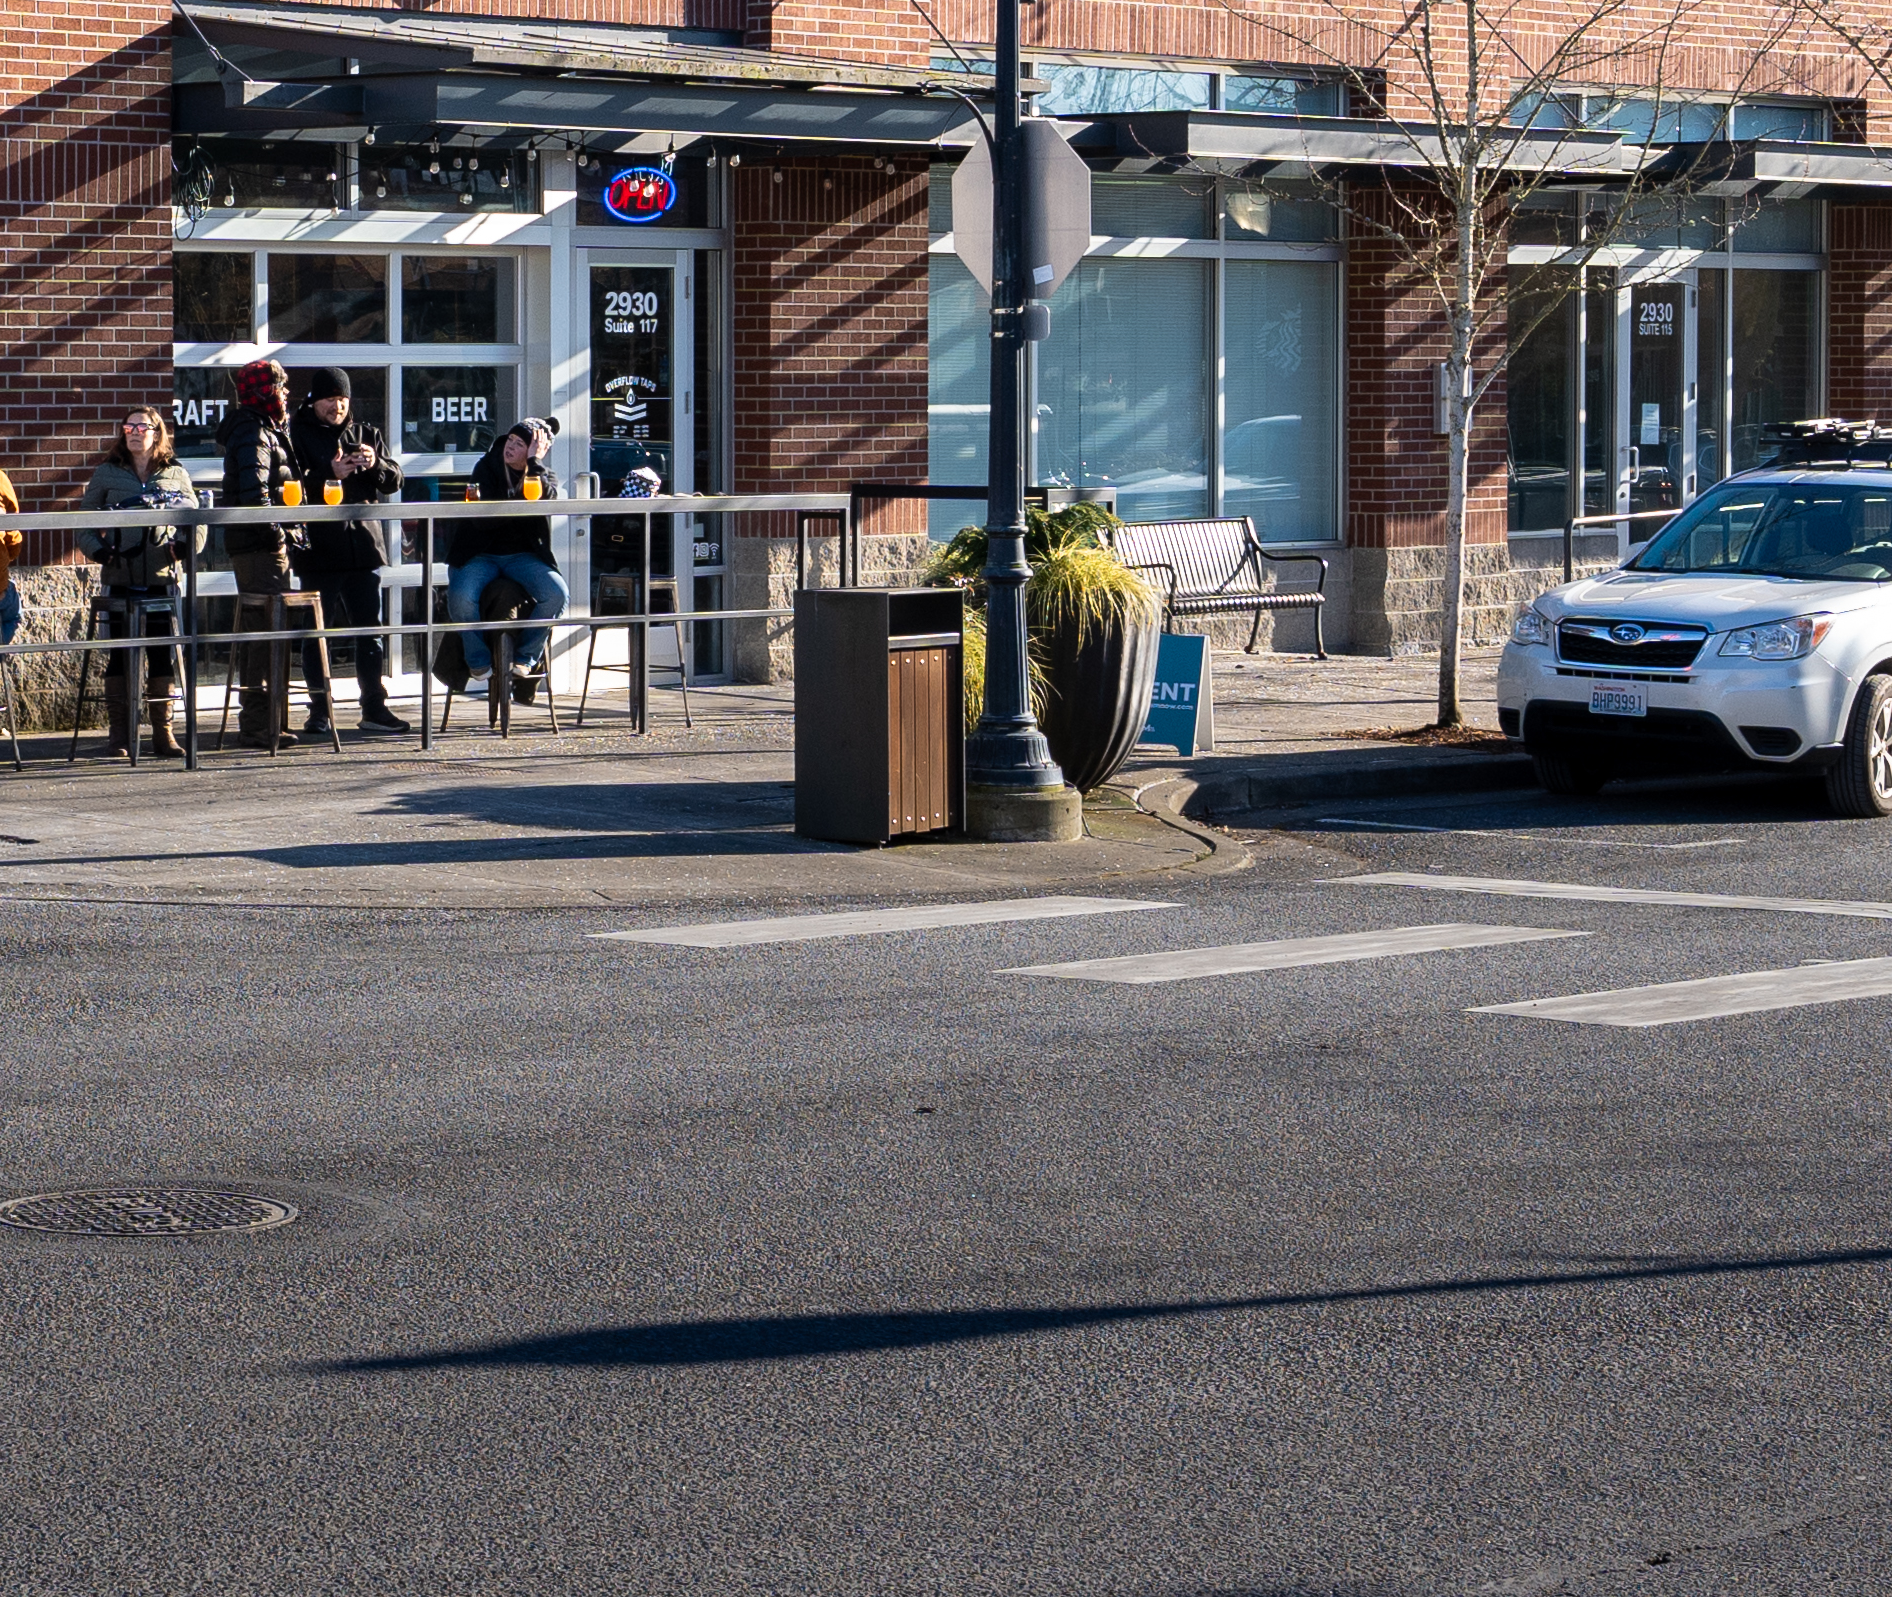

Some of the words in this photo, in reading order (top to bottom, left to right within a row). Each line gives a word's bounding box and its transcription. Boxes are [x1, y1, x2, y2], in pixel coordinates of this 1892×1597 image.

[609, 179, 669, 210] OPEN
[604, 291, 658, 316] 2930
[1639, 302, 1674, 322] 2930
[604, 317, 635, 333] Suite
[639, 318, 658, 333] 117
[1638, 322, 1660, 336] SUITE
[1661, 323, 1673, 336] 115
[605, 375, 640, 393] OVERFLOW
[640, 377, 657, 393] TAPS
[431, 396, 488, 422] BEER
[1592, 691, 1642, 712] BHP9991
